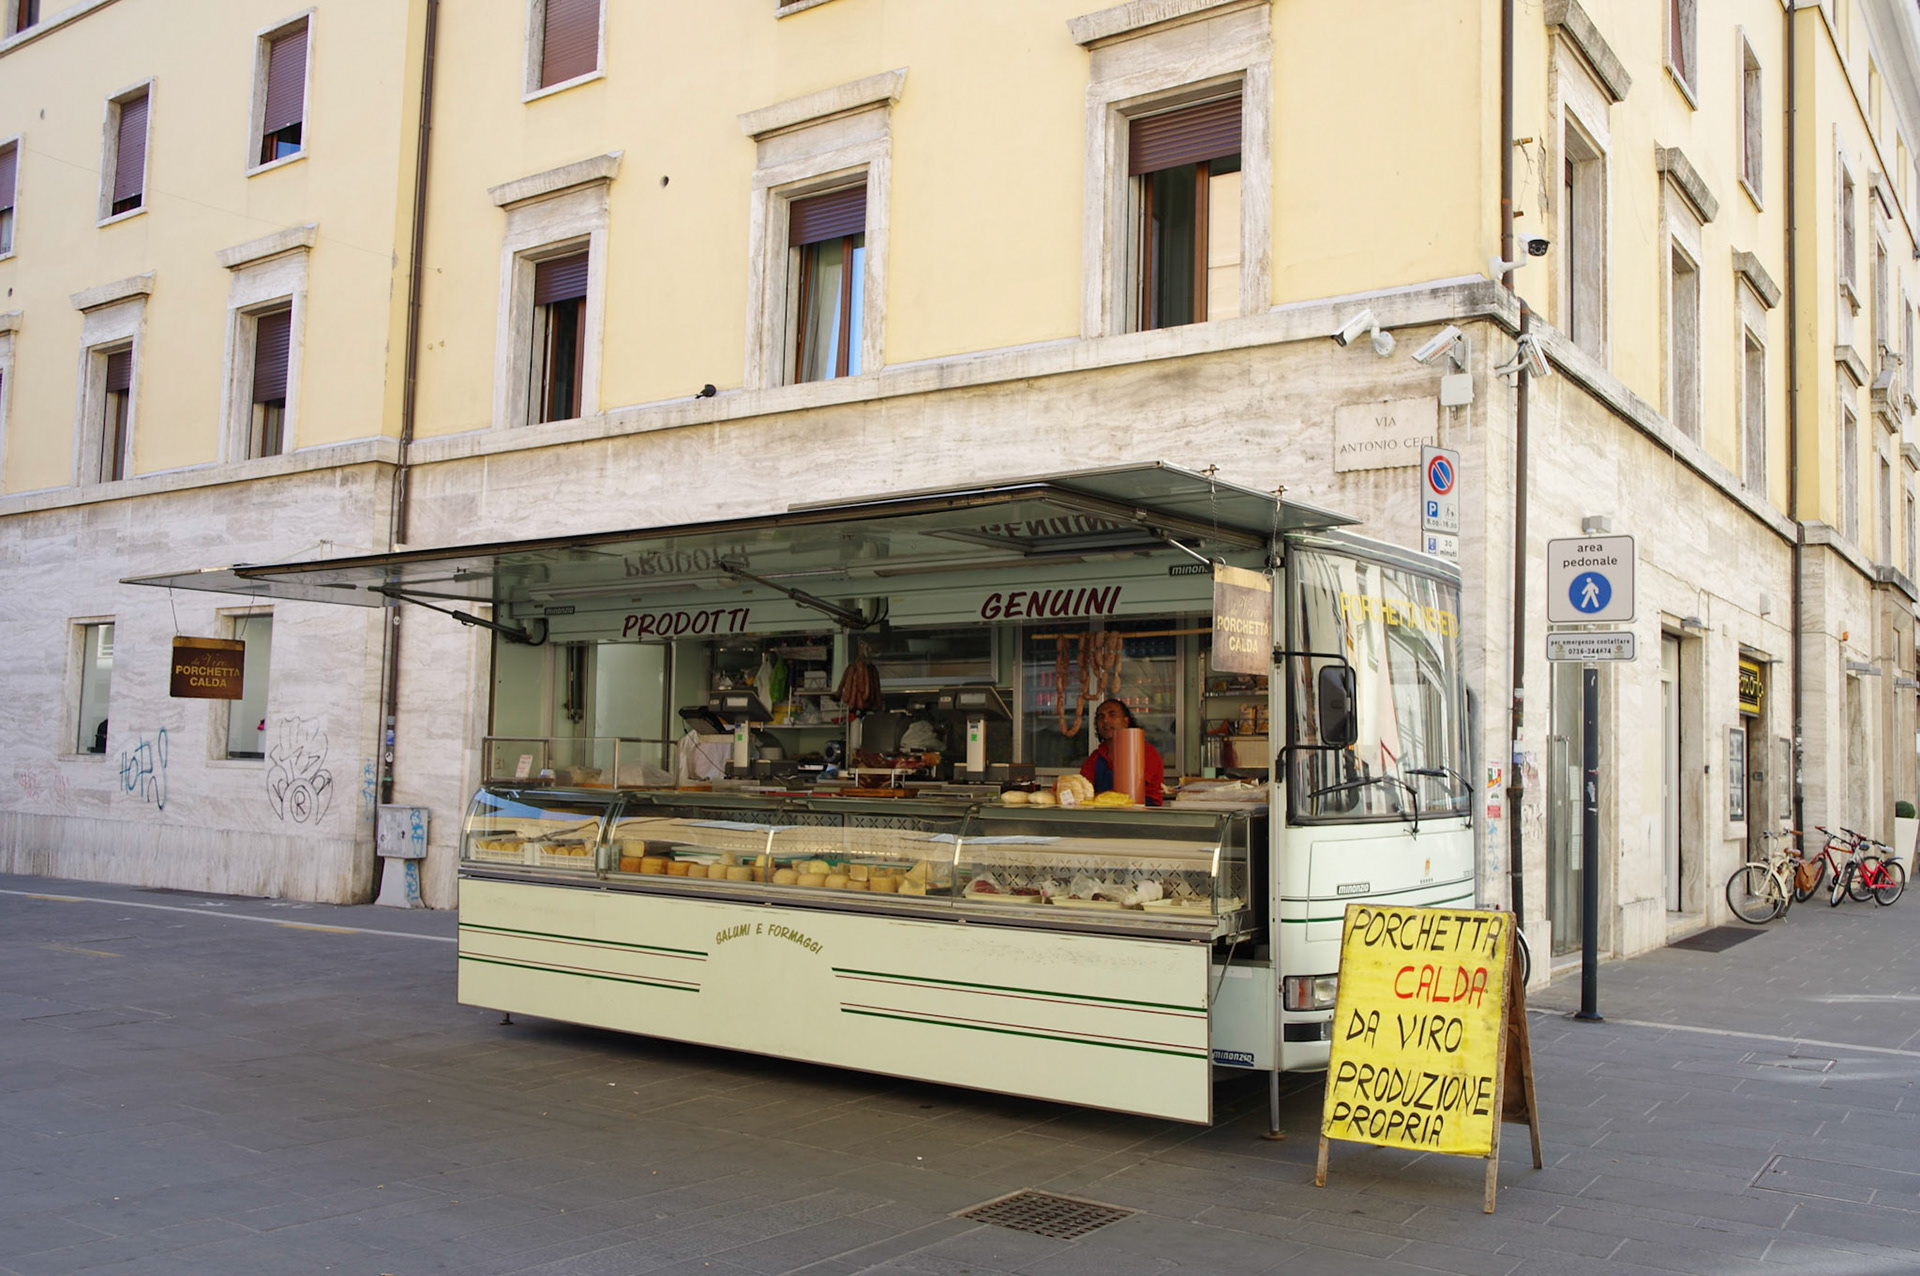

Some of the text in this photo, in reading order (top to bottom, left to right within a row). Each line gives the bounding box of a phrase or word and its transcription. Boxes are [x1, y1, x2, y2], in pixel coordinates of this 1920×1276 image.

[1375, 417, 1397, 427] VIA
[1340, 436, 1434, 454] ANTONIO CECI
[1577, 544, 1603, 552] area
[1171, 565, 1209, 575] minon
[1563, 556, 1618, 568] pedonale
[981, 586, 1123, 620] GENUINI
[1340, 592, 1419, 629] PORCHETTA
[622, 608, 750, 638] PRODOTTI
[1217, 615, 1269, 636] PORCHETTA
[1228, 636, 1259, 653] CALDA
[1563, 639, 1595, 647] emergenze
[175, 665, 240, 677] PORCHETTA
[190, 676, 227, 687] CALDA
[1338, 884, 1369, 894] minonzio
[716, 923, 823, 954] SALUMI E FORMAGGI
[1348, 909, 1502, 959] PORCHETTA
[1394, 964, 1488, 1009] CALDA
[1346, 1008, 1463, 1053] DA VIRO
[1213, 1051, 1253, 1062] minonzio
[1333, 1060, 1492, 1116] PRODUZIONE
[1327, 1101, 1444, 1147] PROPRIA
